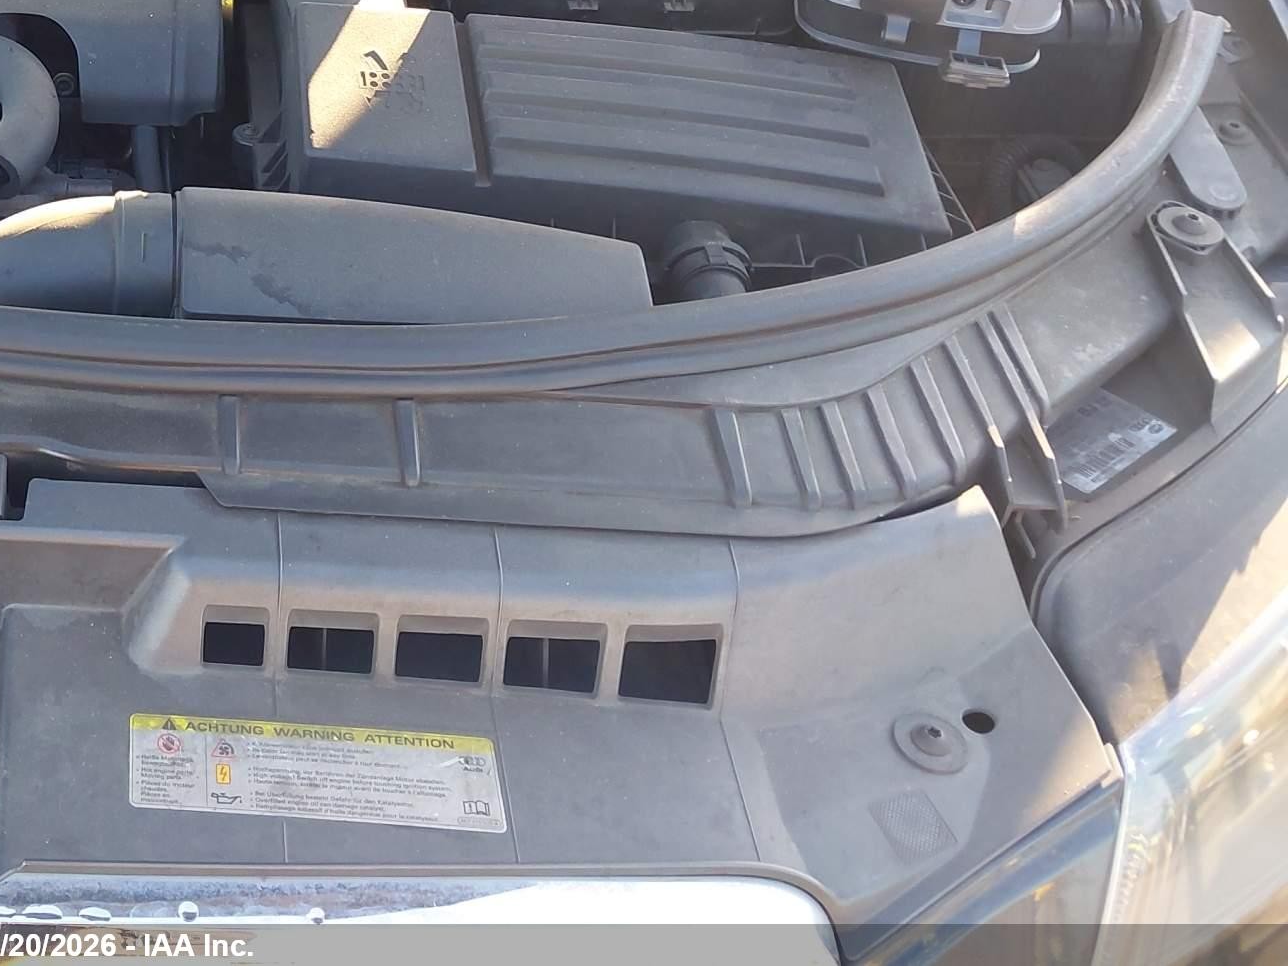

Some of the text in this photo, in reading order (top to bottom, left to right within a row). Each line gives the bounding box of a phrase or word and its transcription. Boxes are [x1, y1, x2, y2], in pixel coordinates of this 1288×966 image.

[184, 722, 264, 735] ACHTUNG
[273, 727, 354, 741] WARNING
[364, 734, 455, 749] ATTENTION
